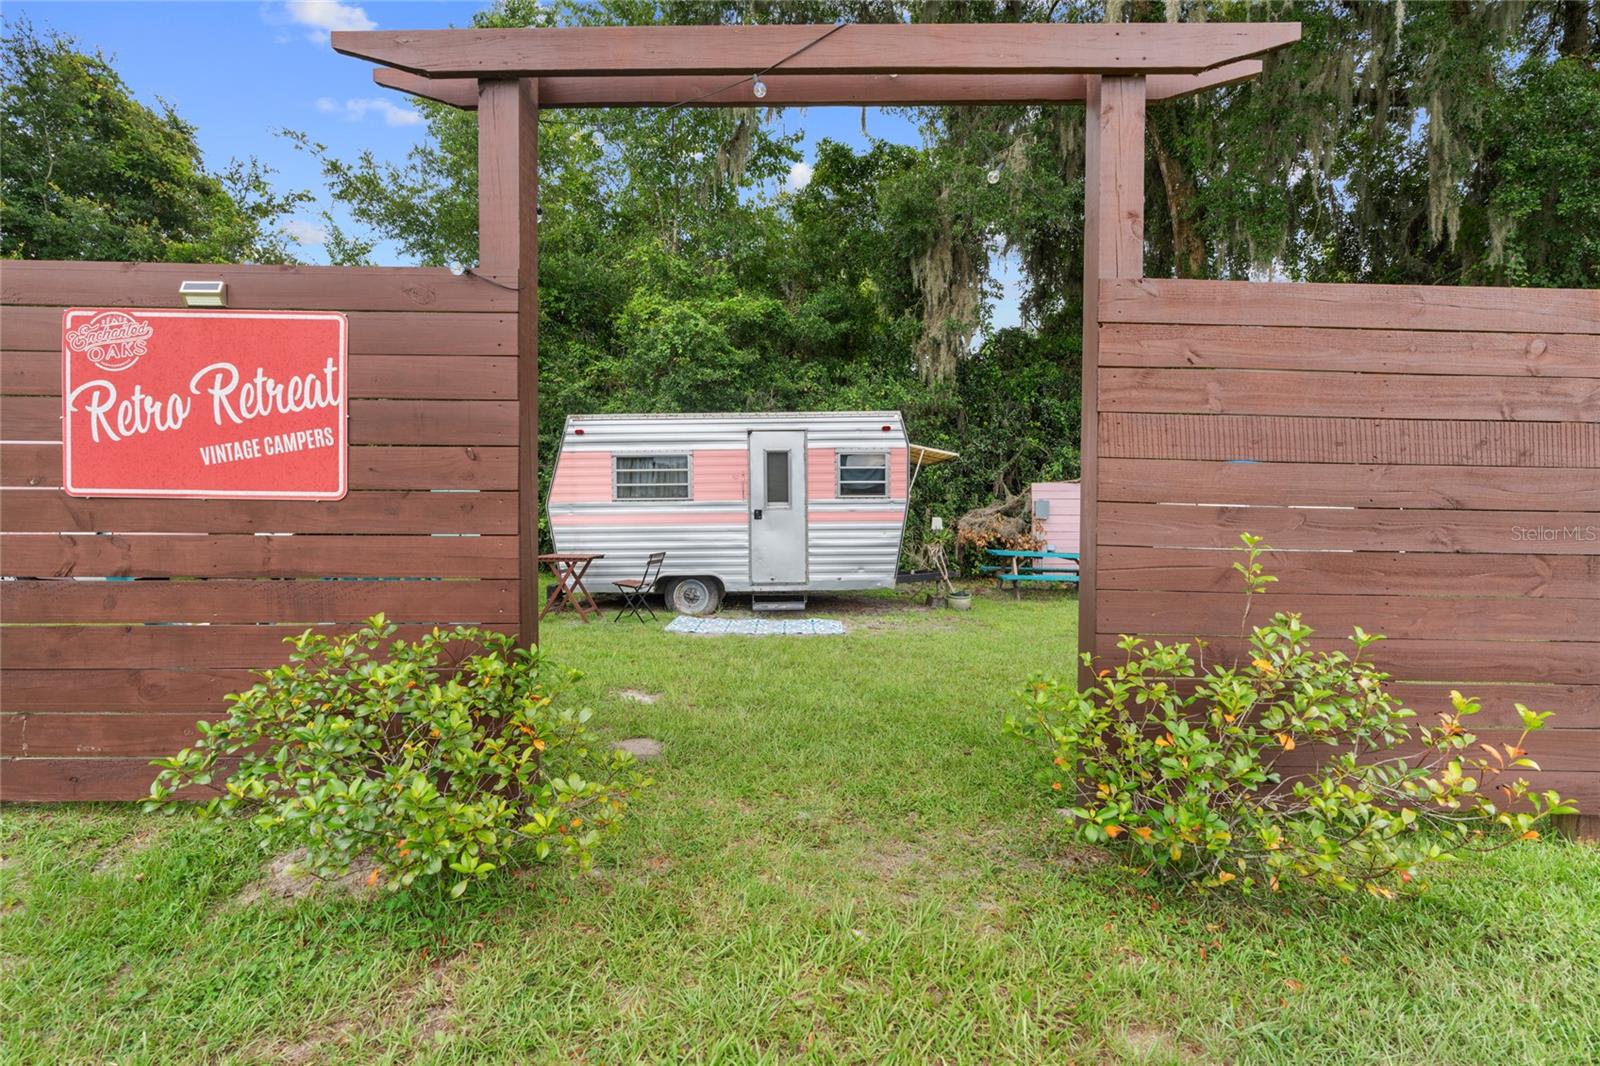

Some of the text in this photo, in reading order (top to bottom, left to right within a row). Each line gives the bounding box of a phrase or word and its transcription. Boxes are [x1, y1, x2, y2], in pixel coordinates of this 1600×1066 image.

[66, 320, 154, 352] Enchanted
[87, 339, 148, 362] OAKS
[69, 357, 342, 443] Retro Retreat
[200, 427, 334, 465] VINTAGE CAMPERS
